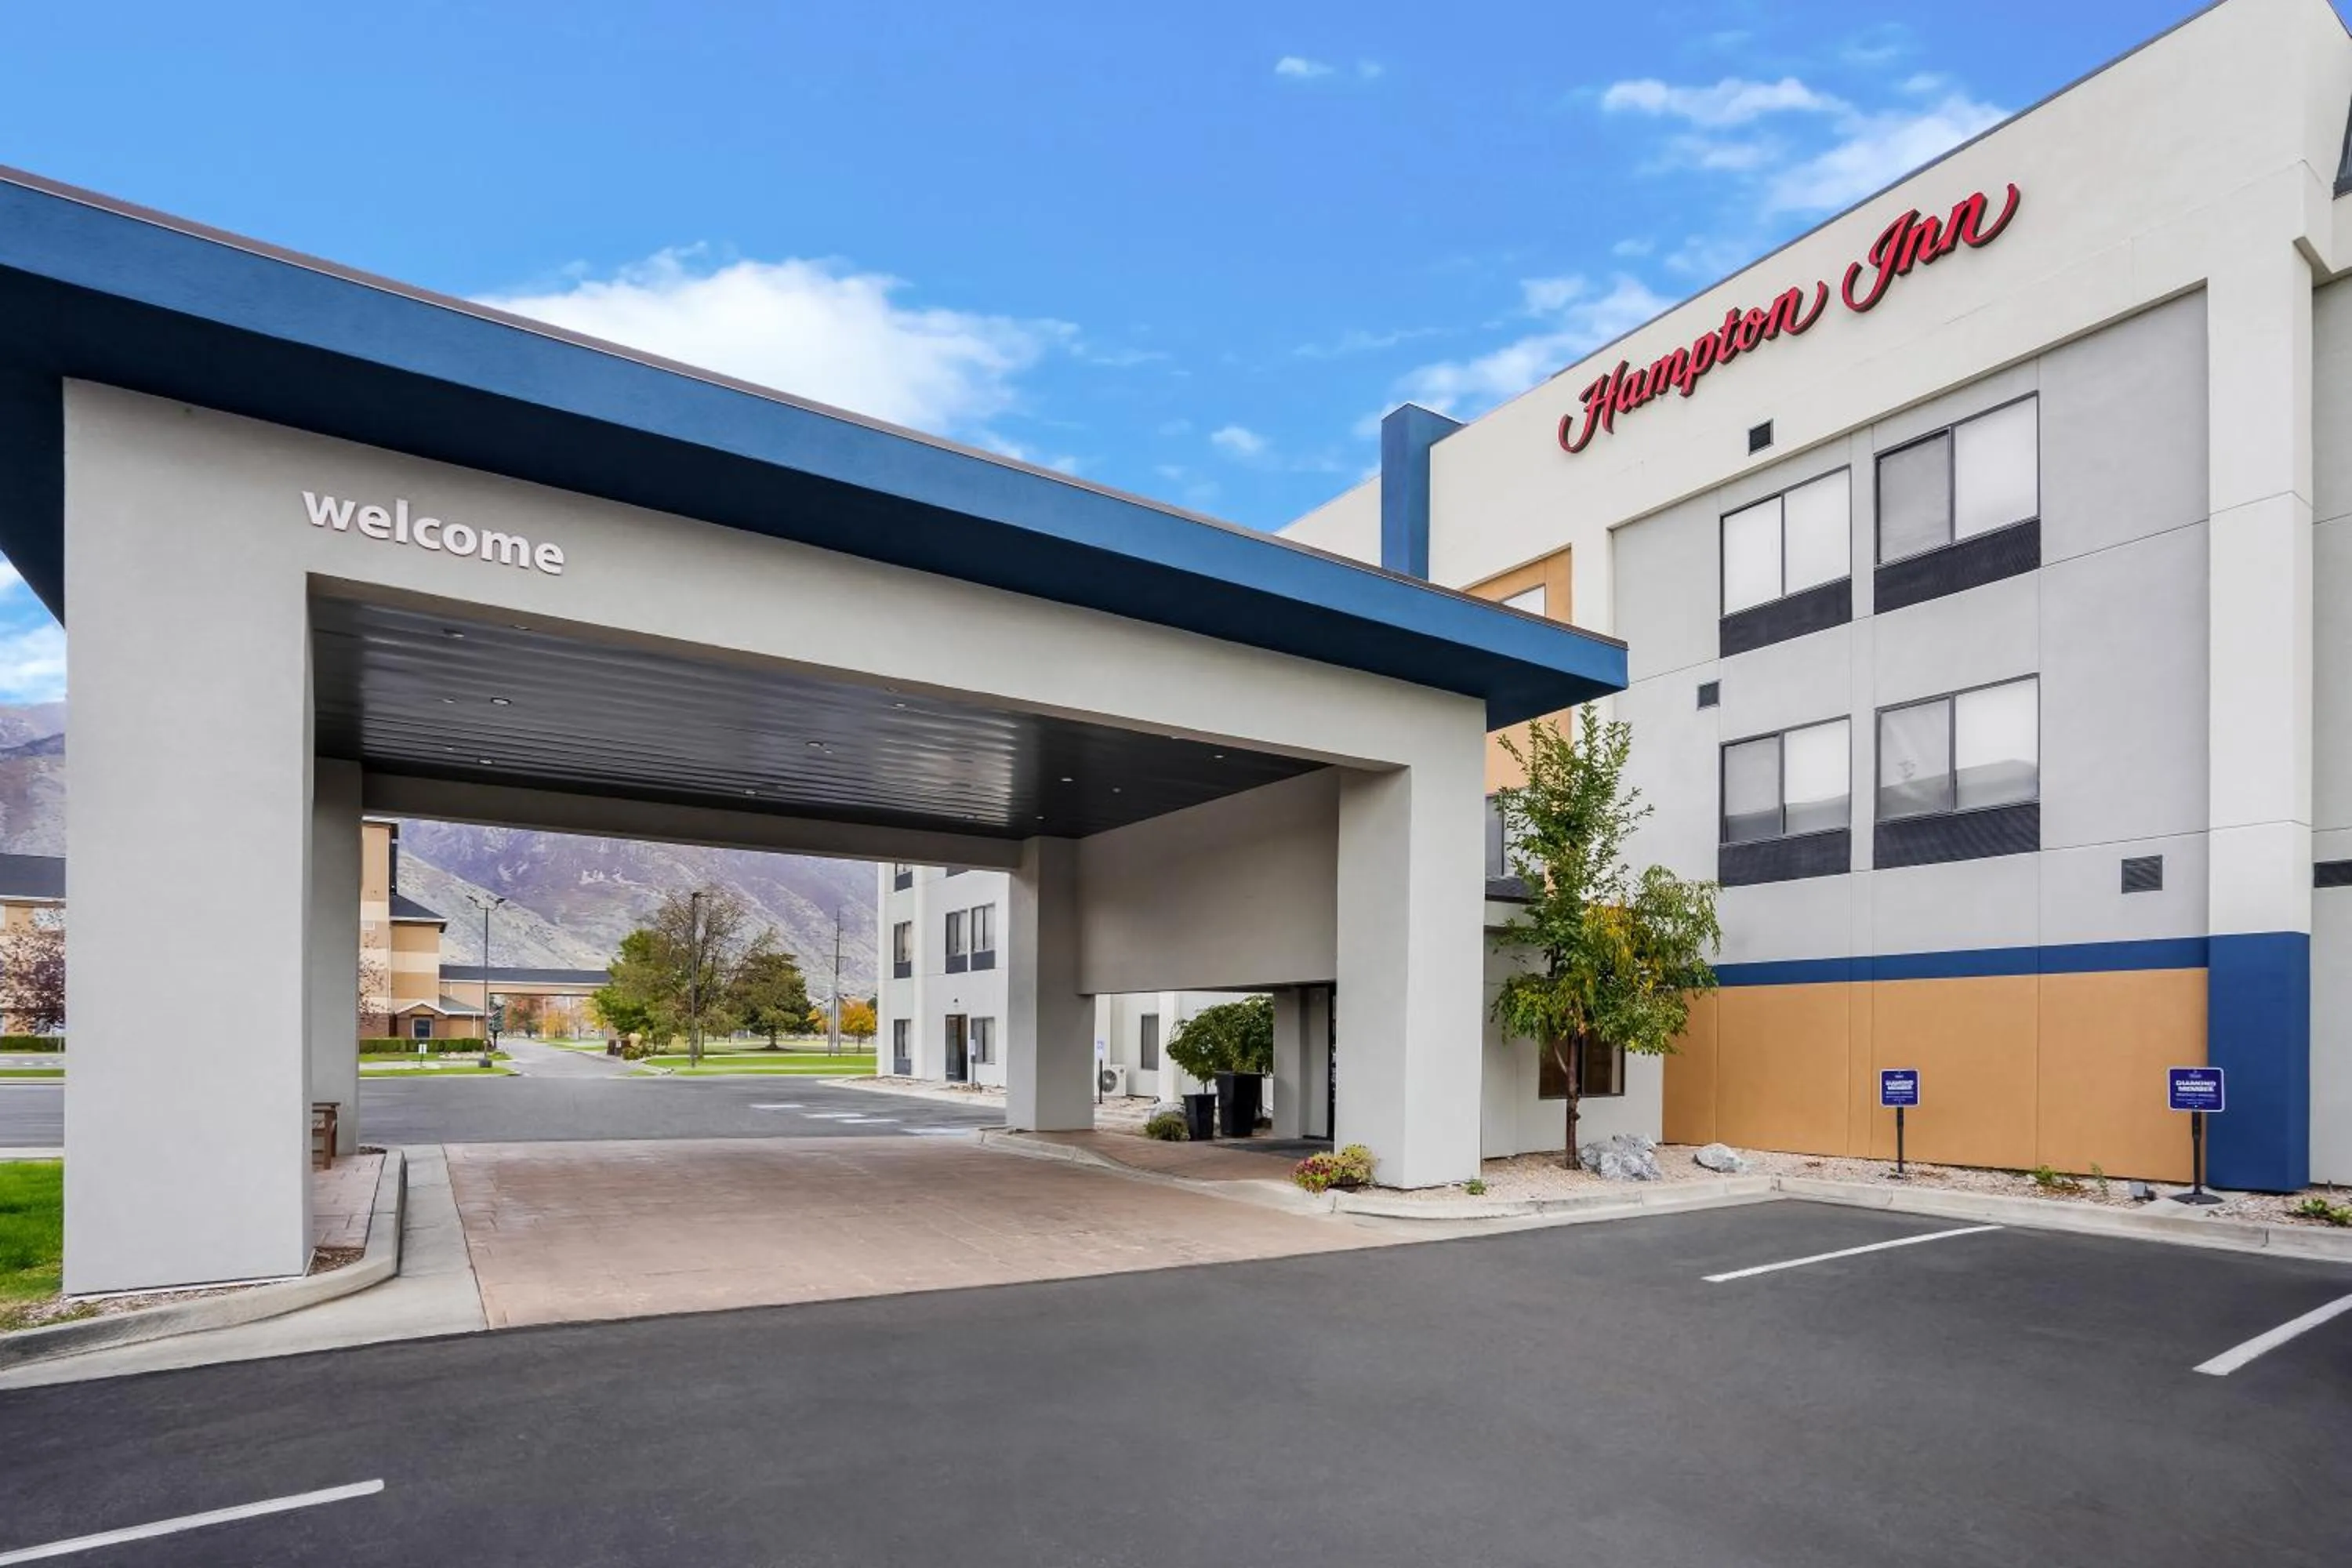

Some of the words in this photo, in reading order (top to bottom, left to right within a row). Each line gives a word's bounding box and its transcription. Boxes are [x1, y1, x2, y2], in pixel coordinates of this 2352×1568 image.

[1558, 281, 1828, 452] Hampton
[1842, 183, 2020, 312] Inn
[303, 491, 564, 575] welcome
